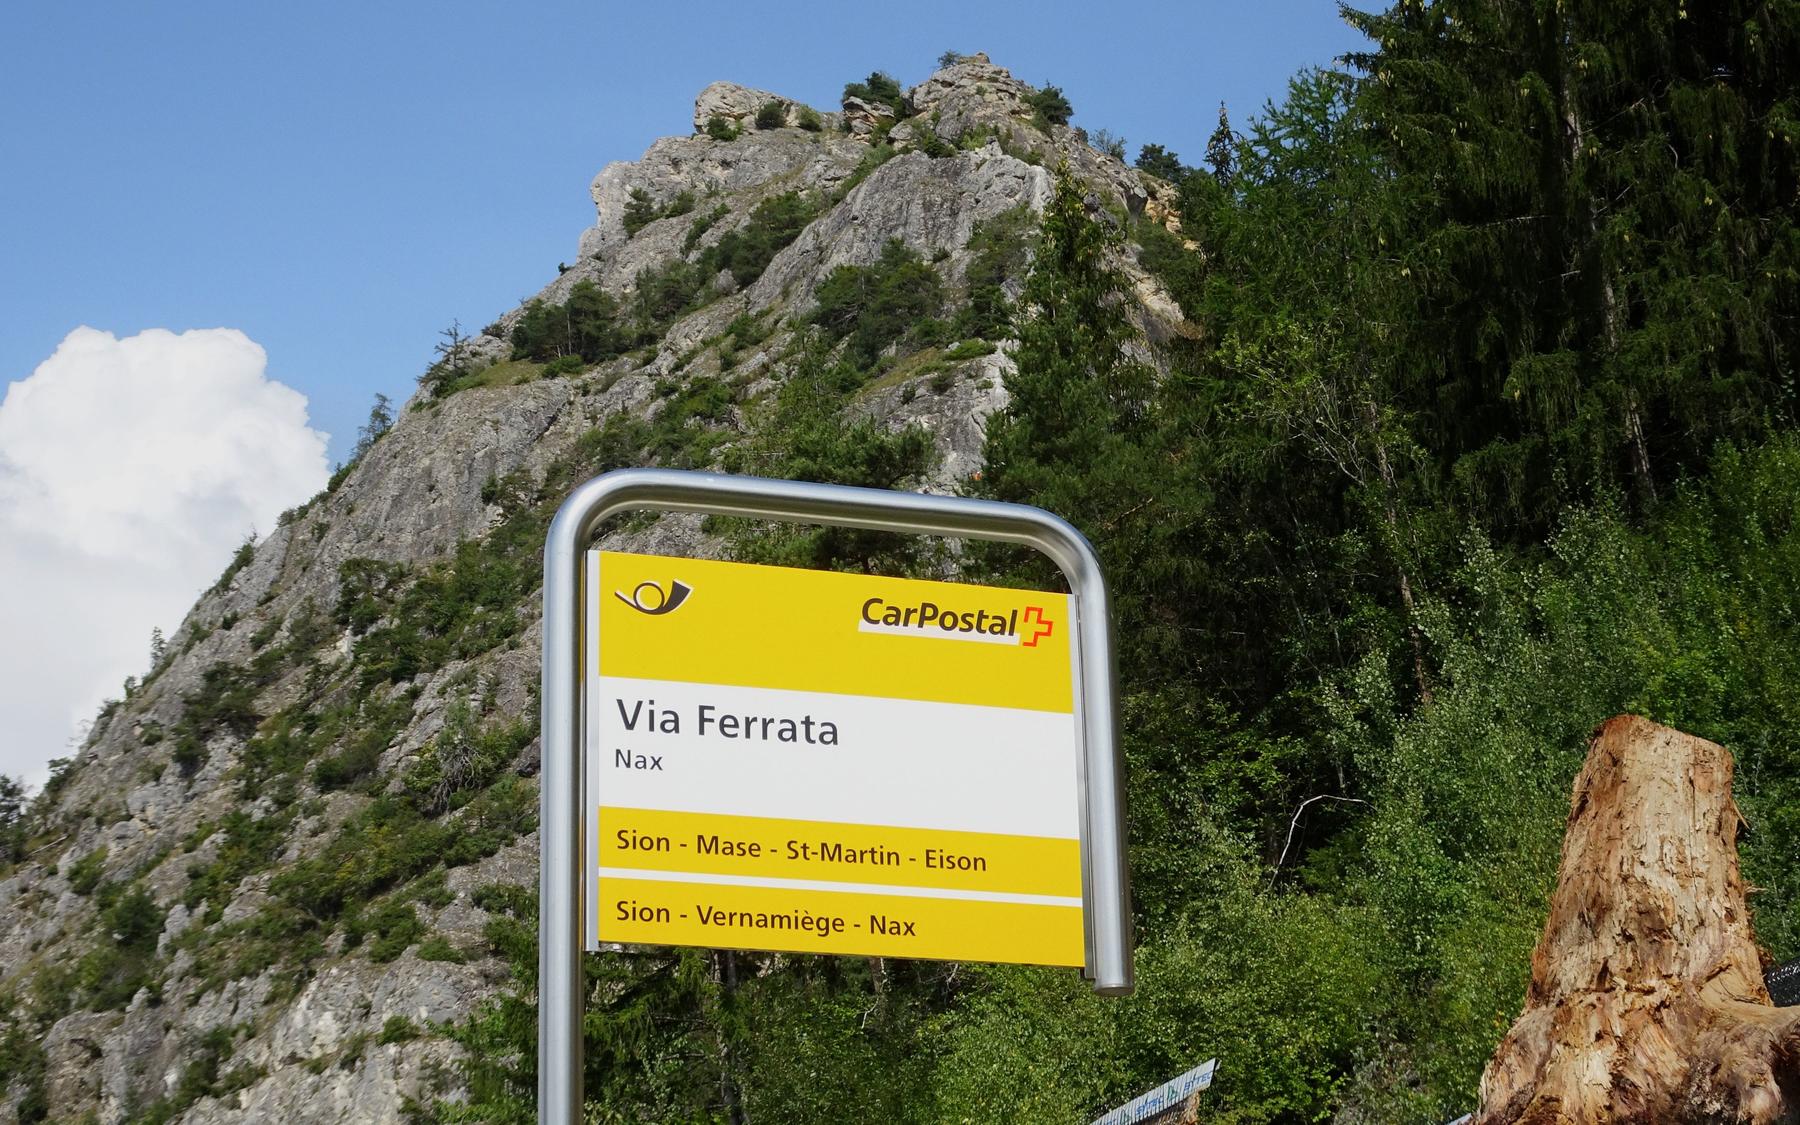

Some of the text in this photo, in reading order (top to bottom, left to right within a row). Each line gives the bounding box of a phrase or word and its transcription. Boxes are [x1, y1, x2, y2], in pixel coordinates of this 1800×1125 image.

[861, 597, 1018, 637] CarPostal
[616, 698, 838, 746] Via Ferrata
[615, 748, 663, 771] Nax
[616, 829, 670, 852] Sion
[697, 834, 762, 859] Mase
[786, 840, 900, 867] St-Martin
[925, 849, 987, 872] Eison
[616, 900, 670, 923] Sion
[696, 905, 845, 938] Vernamiège
[870, 914, 916, 937] Nax
